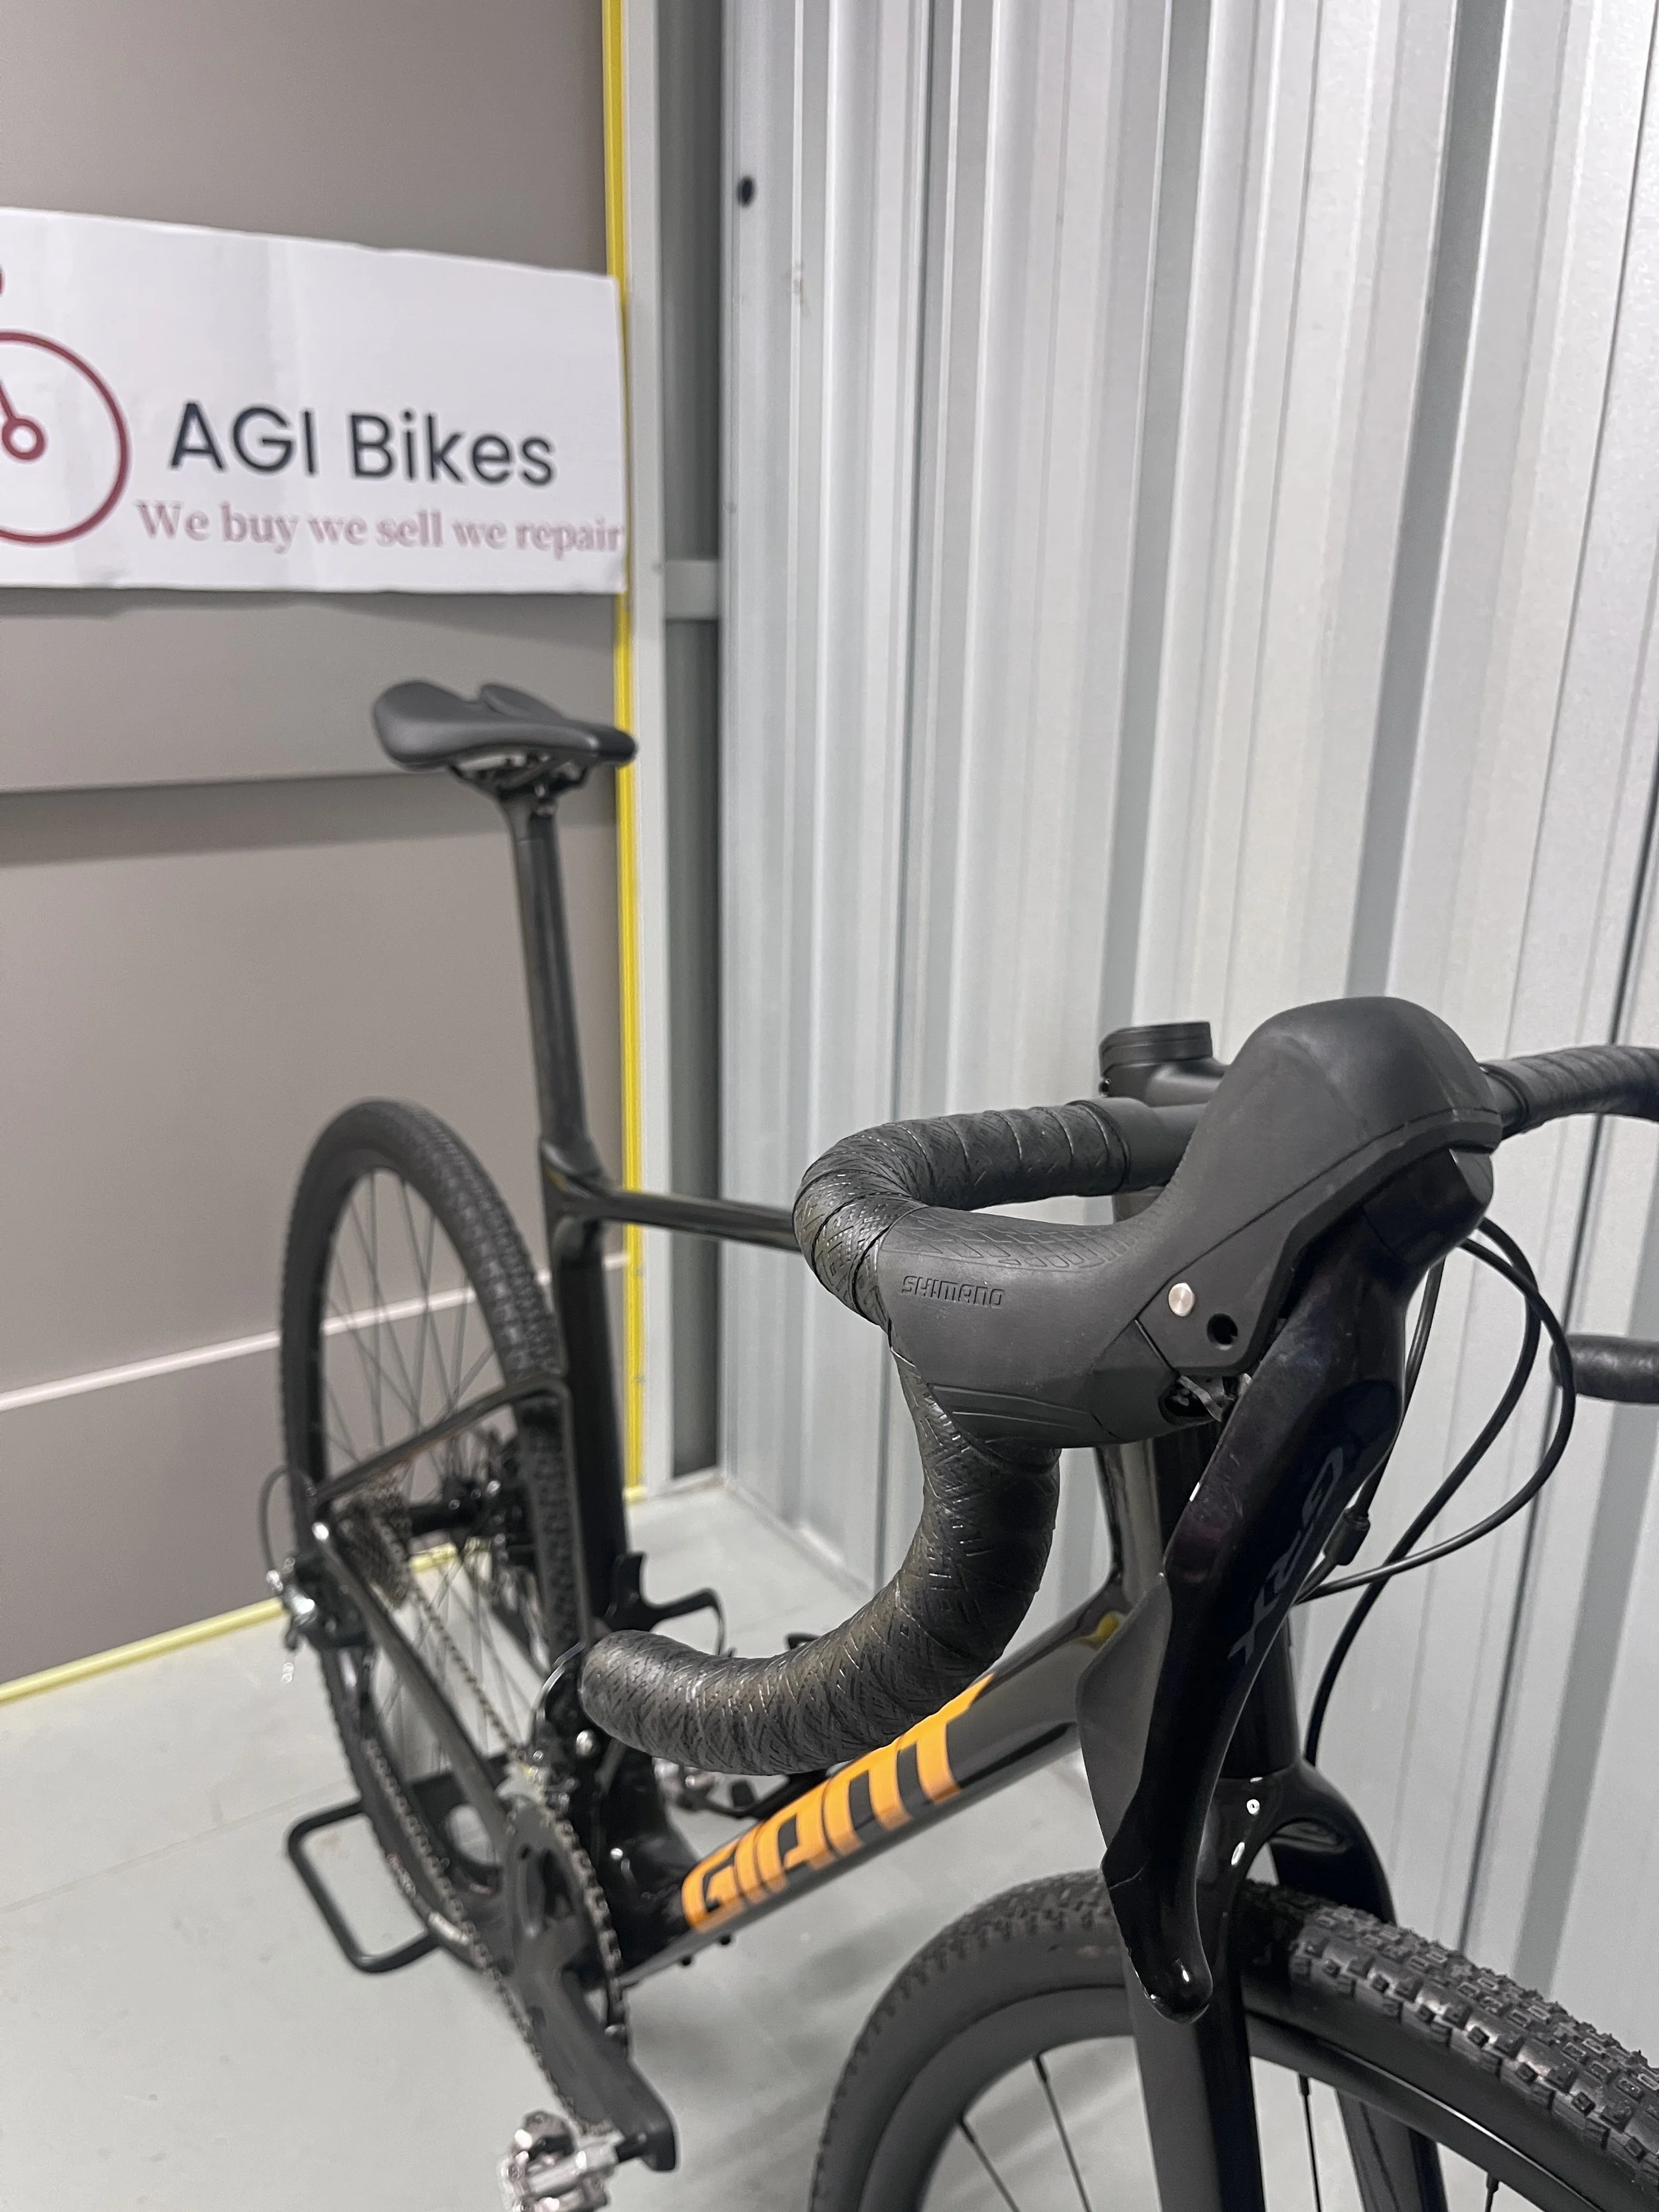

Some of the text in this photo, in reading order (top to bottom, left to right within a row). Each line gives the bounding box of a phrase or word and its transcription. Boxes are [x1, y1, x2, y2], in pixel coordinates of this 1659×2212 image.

[169, 401, 557, 487] AGI Bikes
[135, 500, 624, 561] We buy we sell we repair
[901, 1275, 1005, 1308] SHIMANO
[682, 1674, 994, 1933] GIANT
